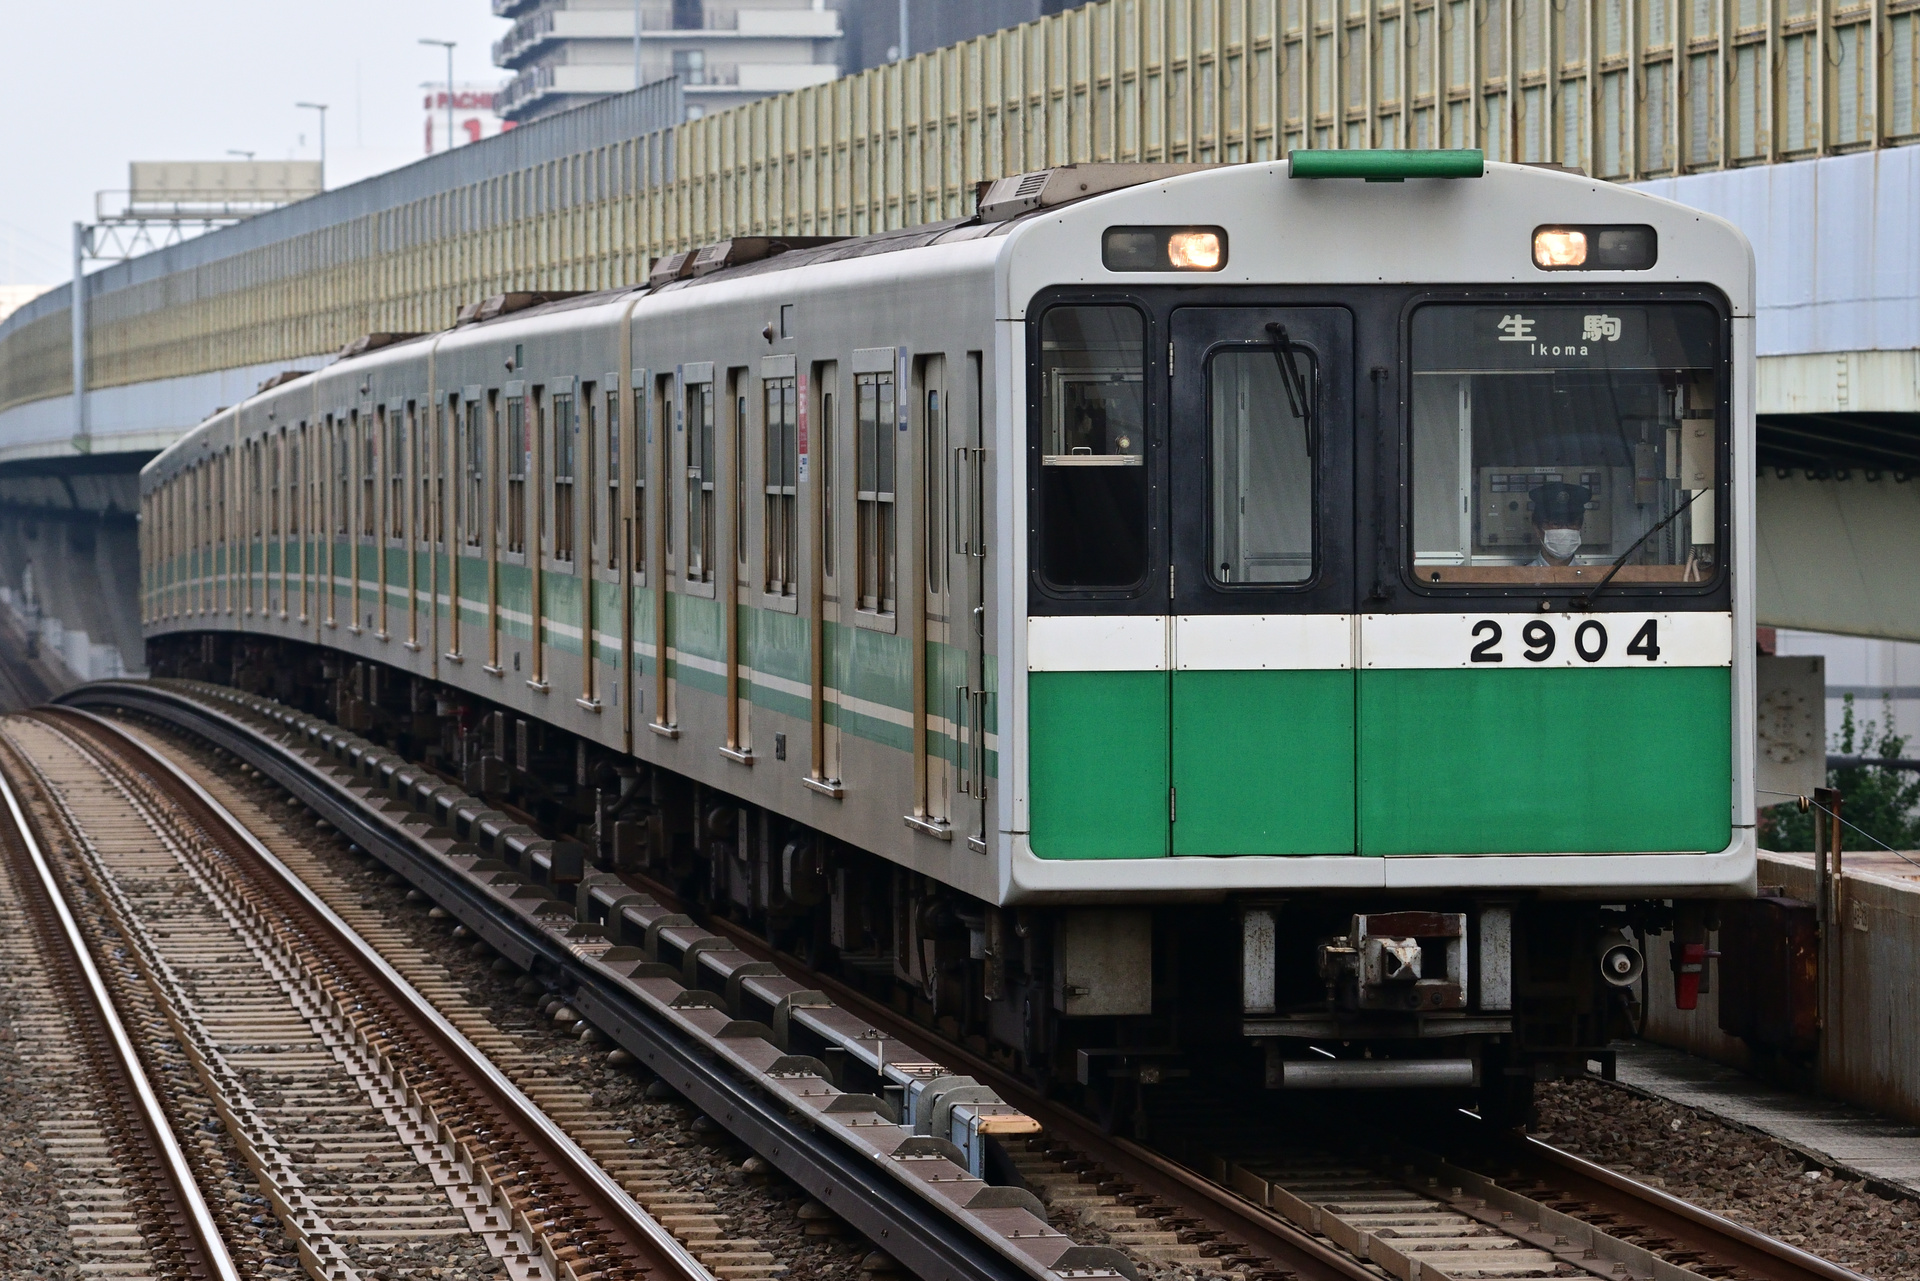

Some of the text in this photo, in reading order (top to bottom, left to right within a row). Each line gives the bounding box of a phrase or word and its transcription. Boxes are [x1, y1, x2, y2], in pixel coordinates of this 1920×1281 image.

[1497, 314, 1622, 342] 生駒
[1530, 343, 1589, 356] Ikoma
[1470, 618, 1661, 663] 2904
